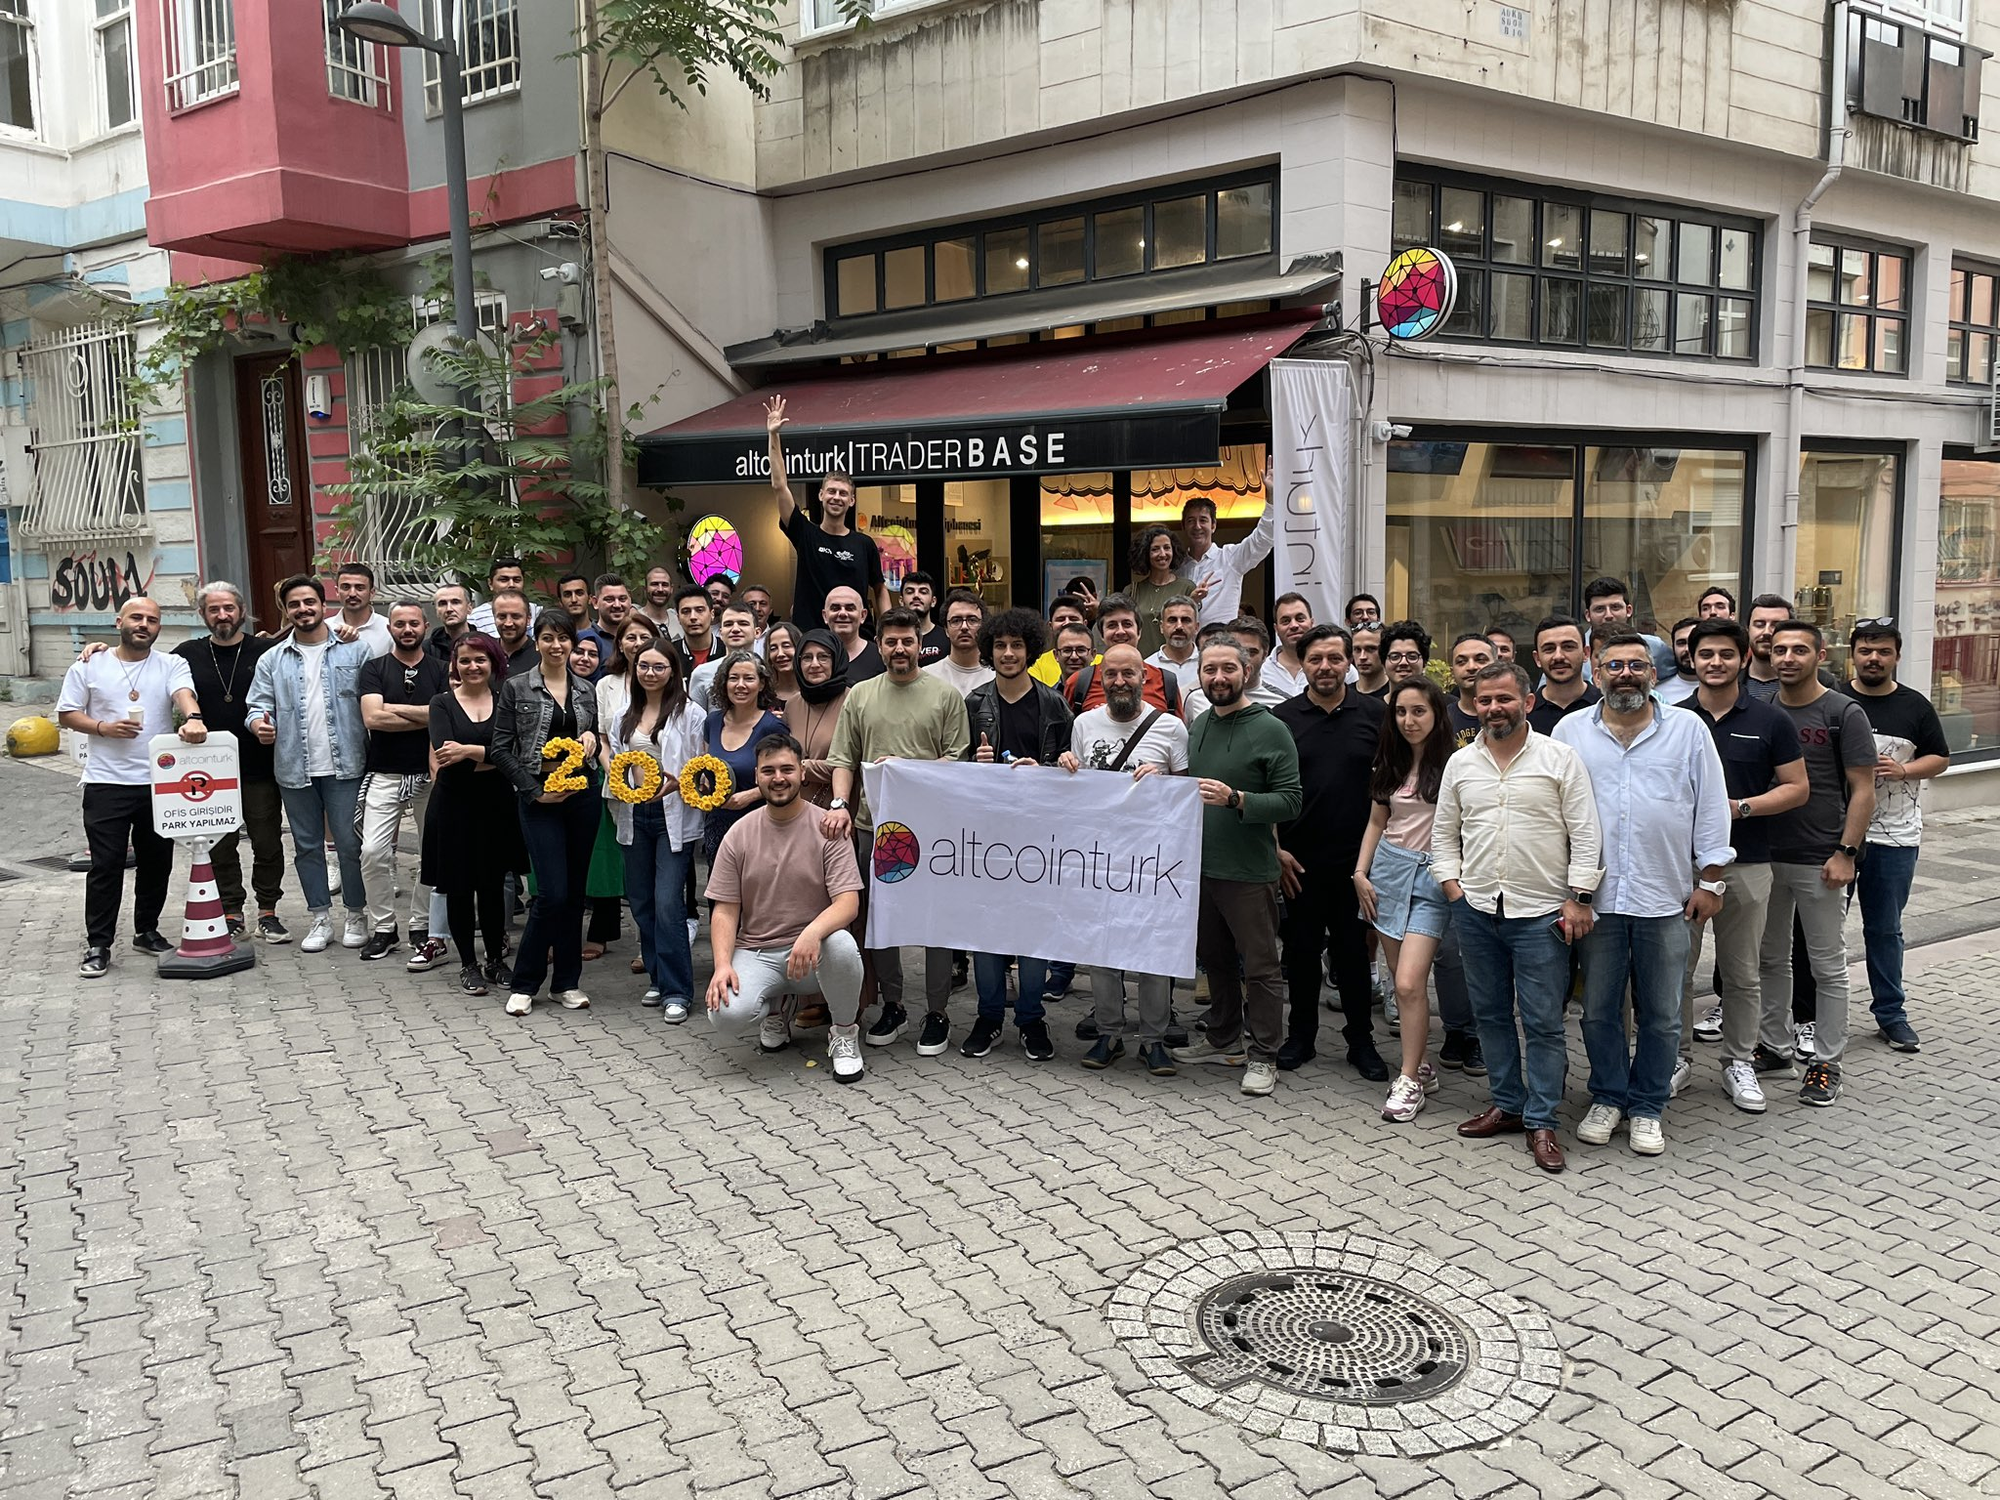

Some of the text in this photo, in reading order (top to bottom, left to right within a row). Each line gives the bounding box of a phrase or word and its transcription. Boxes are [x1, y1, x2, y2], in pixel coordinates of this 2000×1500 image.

[735, 444, 846, 476] altcinturk
[920, 646, 939, 655] VER
[179, 753, 234, 766] altcointurk
[162, 817, 236, 831] PARK YAPILMAZ
[929, 827, 1184, 899] altcointurk
